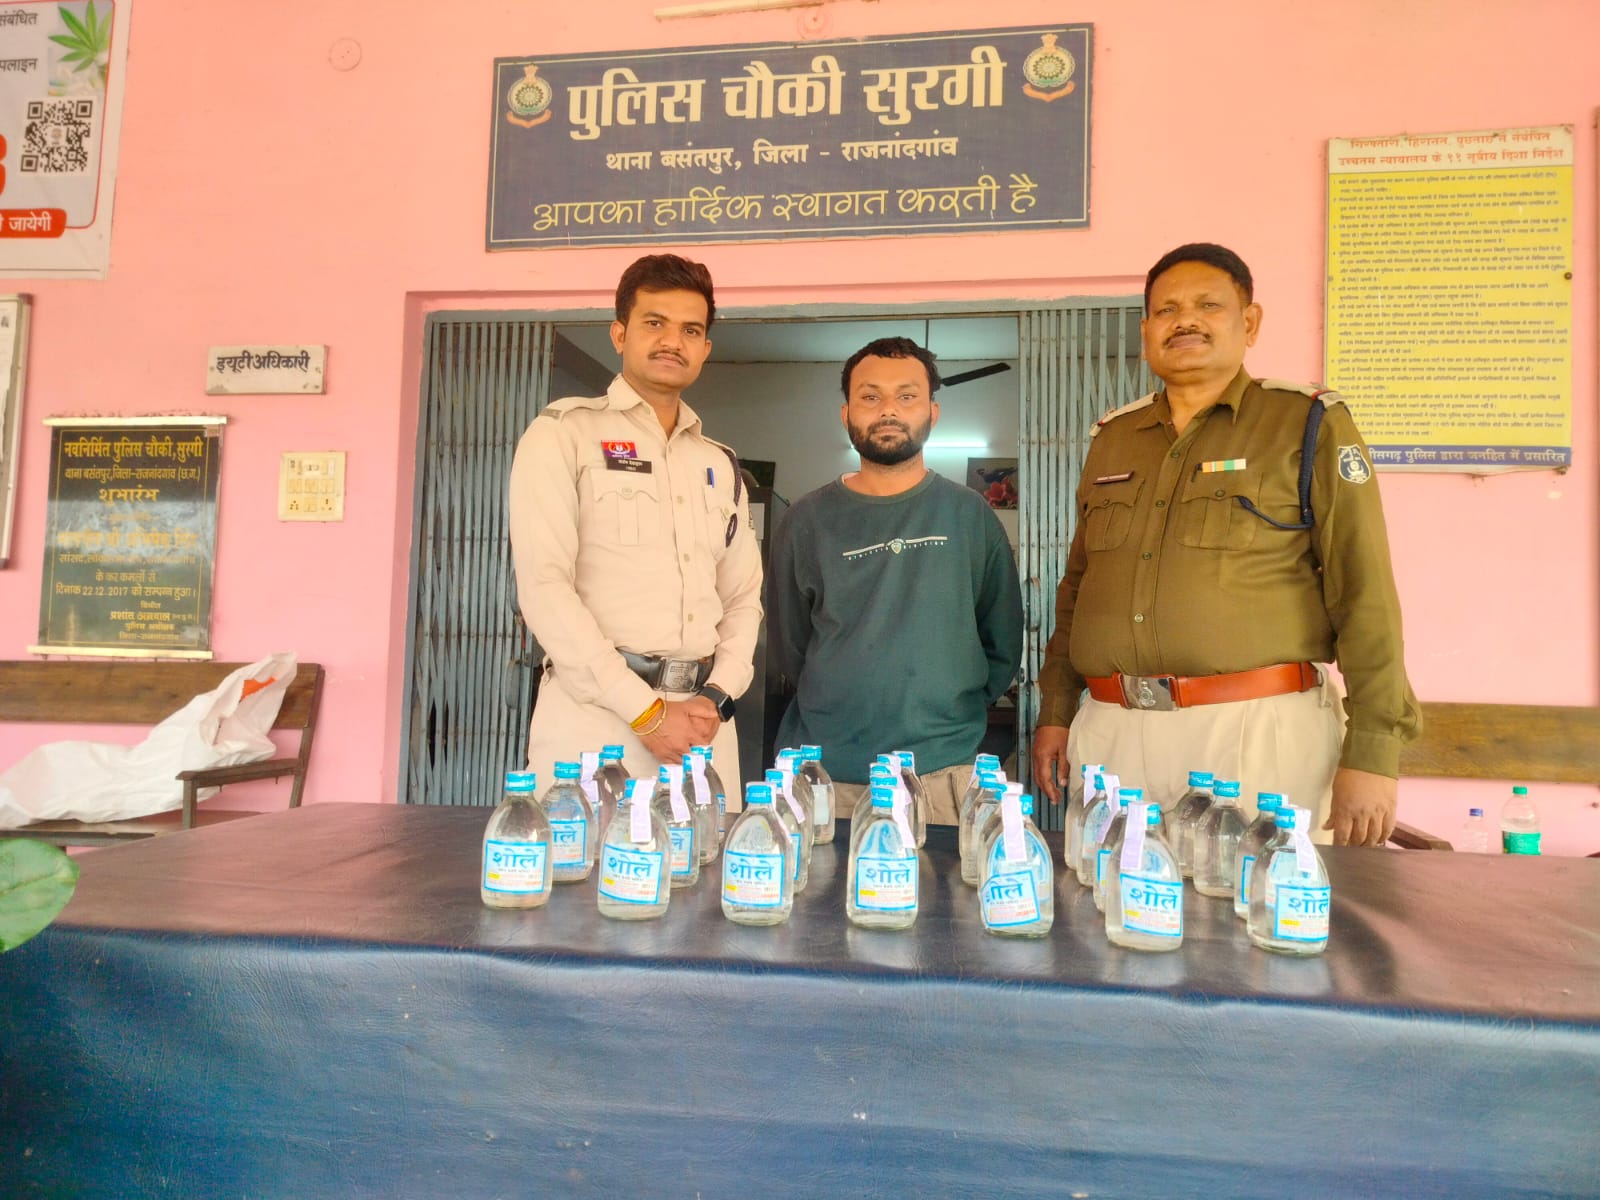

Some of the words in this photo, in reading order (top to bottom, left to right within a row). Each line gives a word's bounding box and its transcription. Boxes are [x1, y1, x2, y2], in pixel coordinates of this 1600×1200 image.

[567, 67, 706, 141] पुलिस
[721, 54, 847, 121] चौकी
[861, 45, 1008, 126] सुरगी
[605, 150, 653, 172] थाना
[660, 141, 742, 175] बसंतपुर,
[753, 139, 809, 166] जिला
[841, 129, 959, 162] राजनांदगांव
[531, 200, 643, 231] आपका
[653, 187, 765, 227] हार्दिक
[772, 187, 886, 221] स्वागत
[896, 174, 1001, 218] करती
[1008, 173, 1038, 214] है
[9, 211, 52, 232] जायेगी
[253, 350, 311, 373] अधिकारी
[64, 436, 111, 457] नवनिर्मित
[113, 437, 143, 462] पुलिस
[1369, 447, 1402, 464] ीसगढ़
[1405, 448, 1436, 464] पुलिस
[1467, 448, 1505, 462] जनहित
[99, 484, 160, 506] शुभारंभ
[492, 847, 539, 869] शोले
[607, 851, 654, 878] शोले
[729, 858, 774, 882] शोले
[865, 863, 911, 884] शोले
[1129, 885, 1178, 910] शोले
